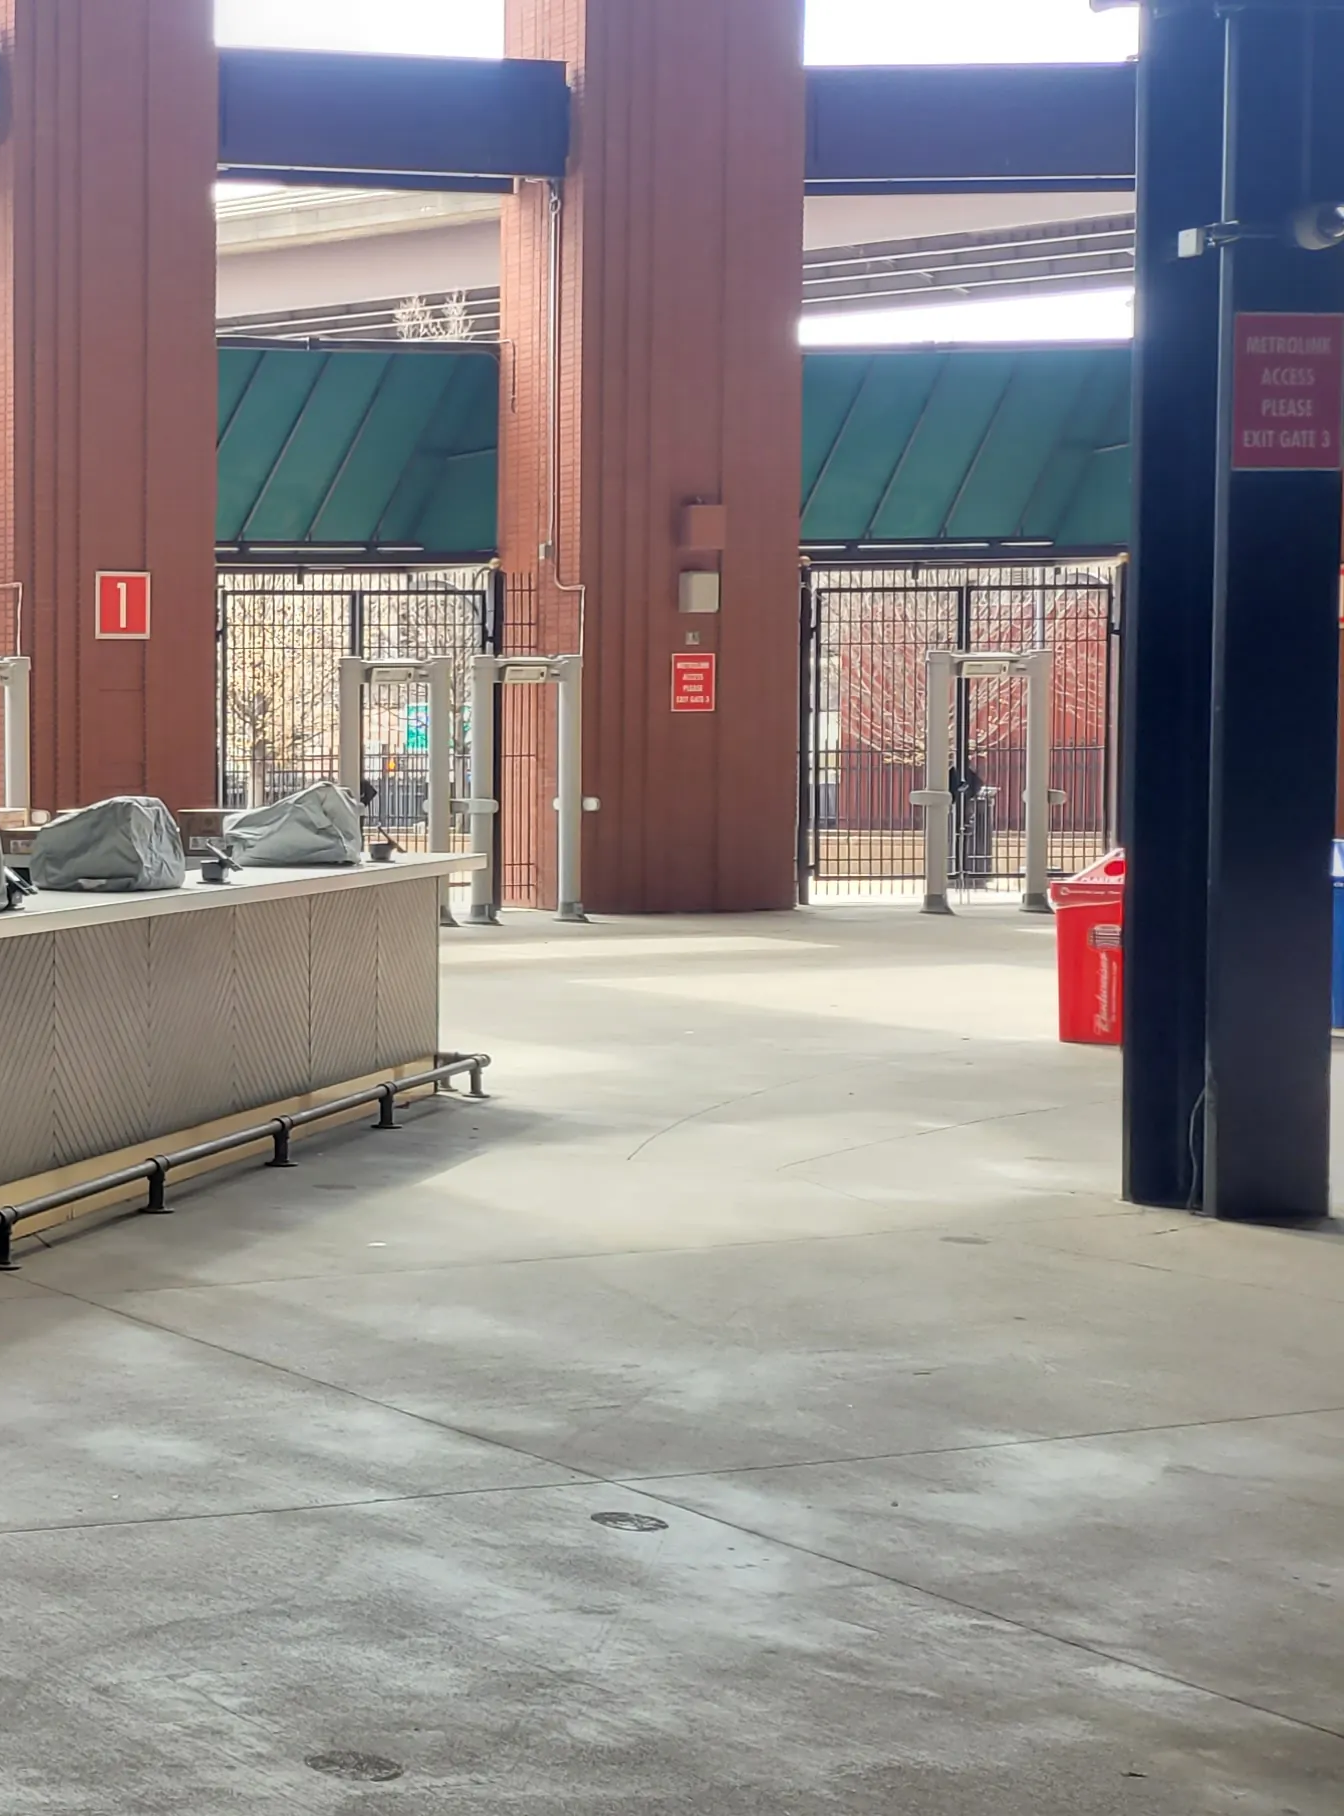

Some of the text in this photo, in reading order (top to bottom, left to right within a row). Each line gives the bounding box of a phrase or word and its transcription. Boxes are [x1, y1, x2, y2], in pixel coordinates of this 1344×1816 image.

[1246, 336, 1332, 355] METROLINK
[1261, 367, 1315, 386] ACCESS
[1261, 399, 1313, 418] PLEASE
[1243, 430, 1330, 448] EXIT GATE 3
[116, 582, 127, 628] 1
